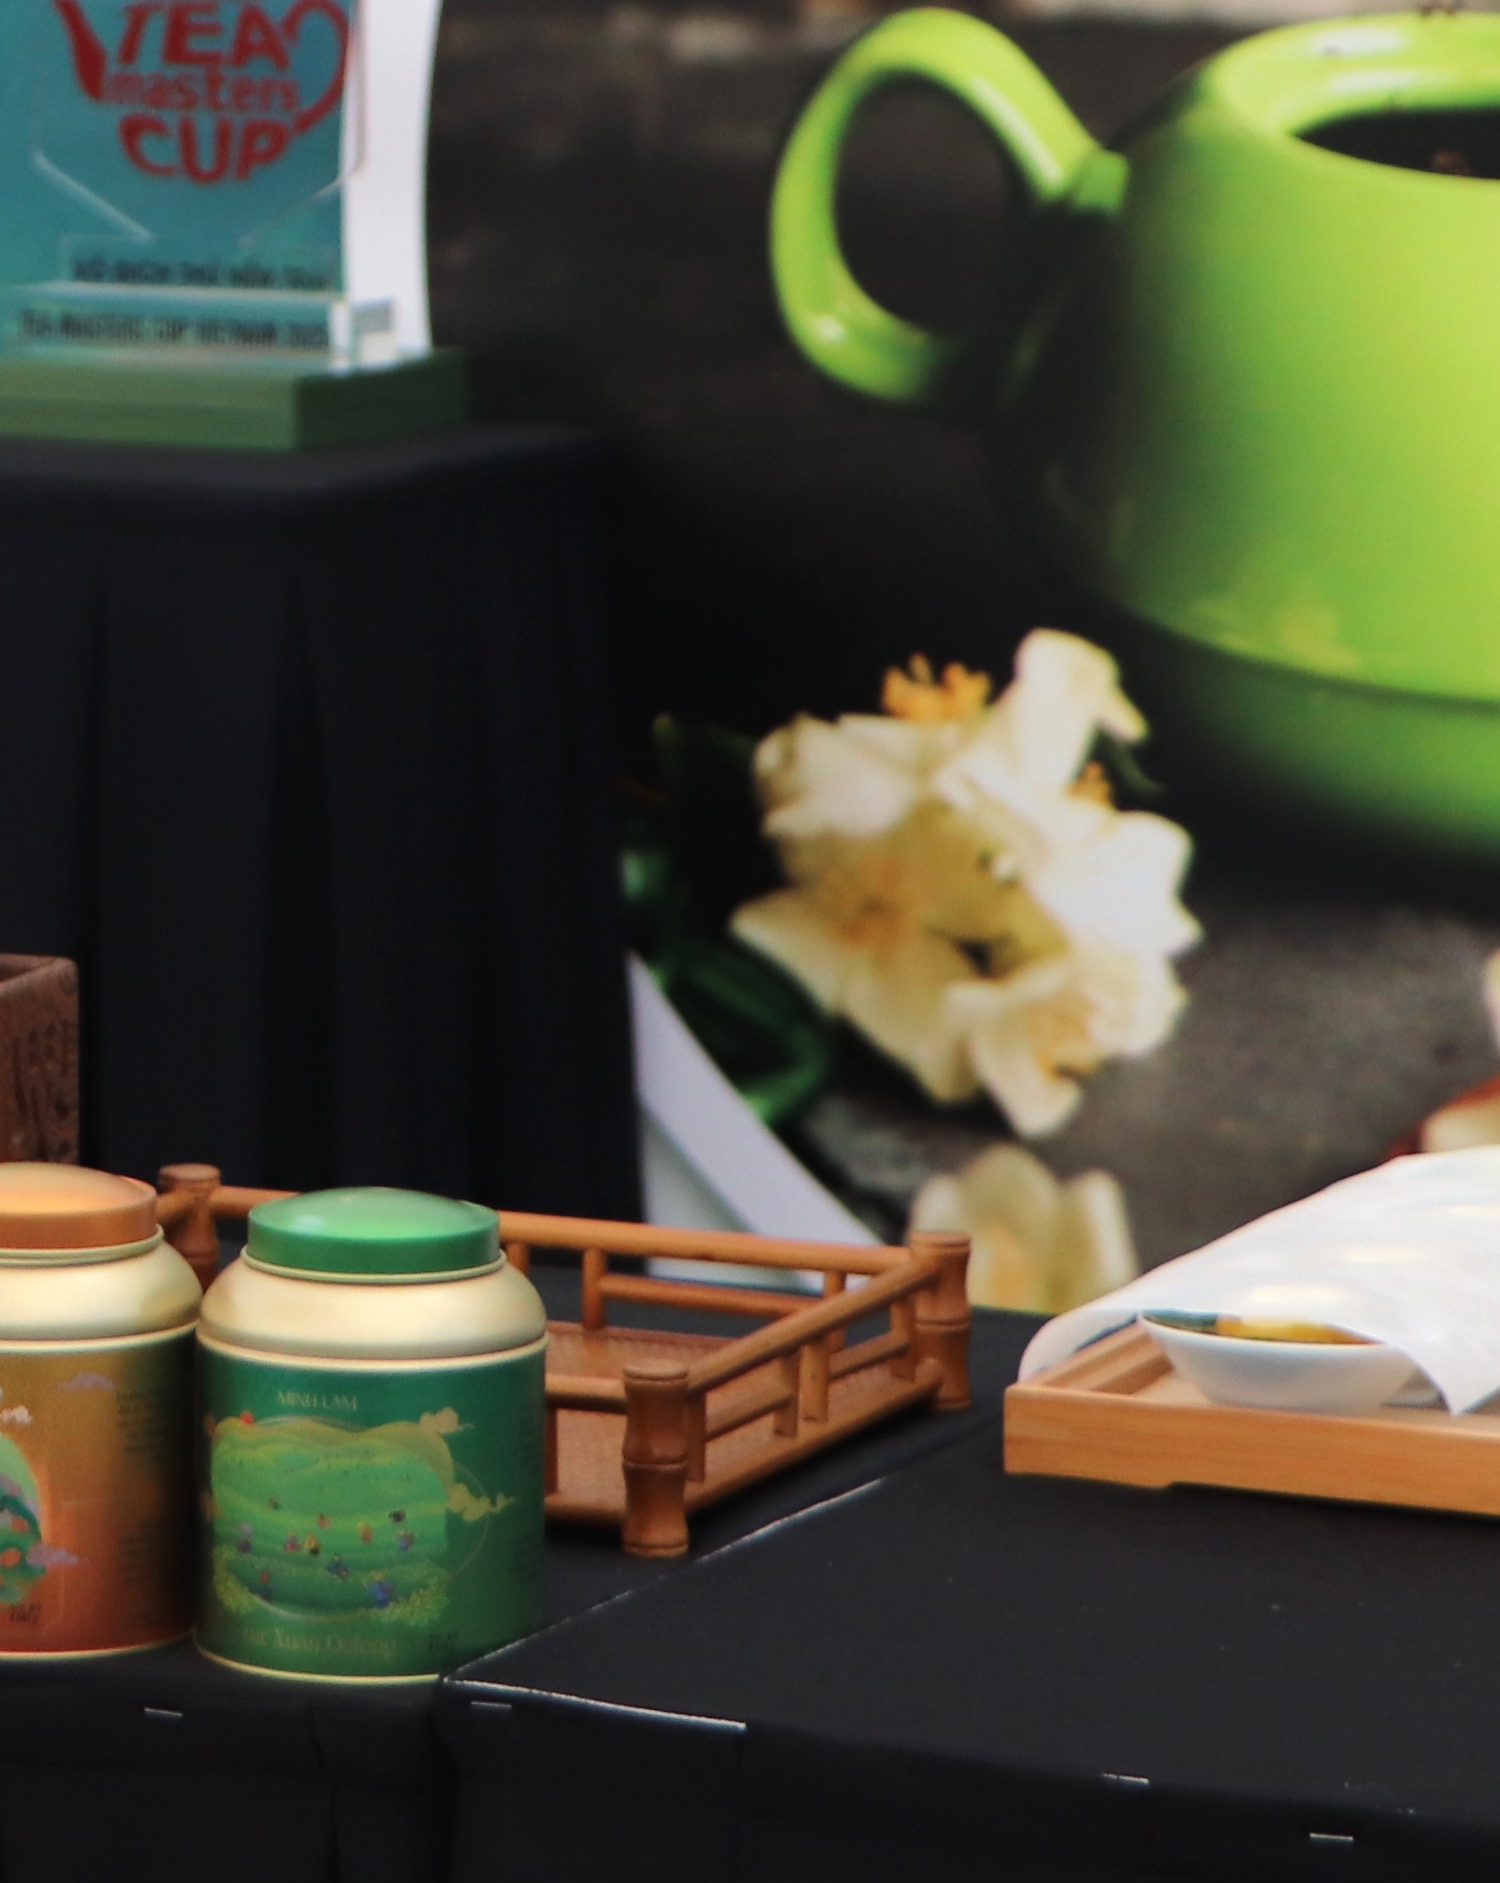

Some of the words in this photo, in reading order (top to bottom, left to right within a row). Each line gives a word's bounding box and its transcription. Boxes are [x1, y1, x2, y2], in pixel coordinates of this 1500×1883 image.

[116, 0, 293, 71] TEA
[104, 69, 300, 114] masters
[118, 113, 296, 185] CUP
